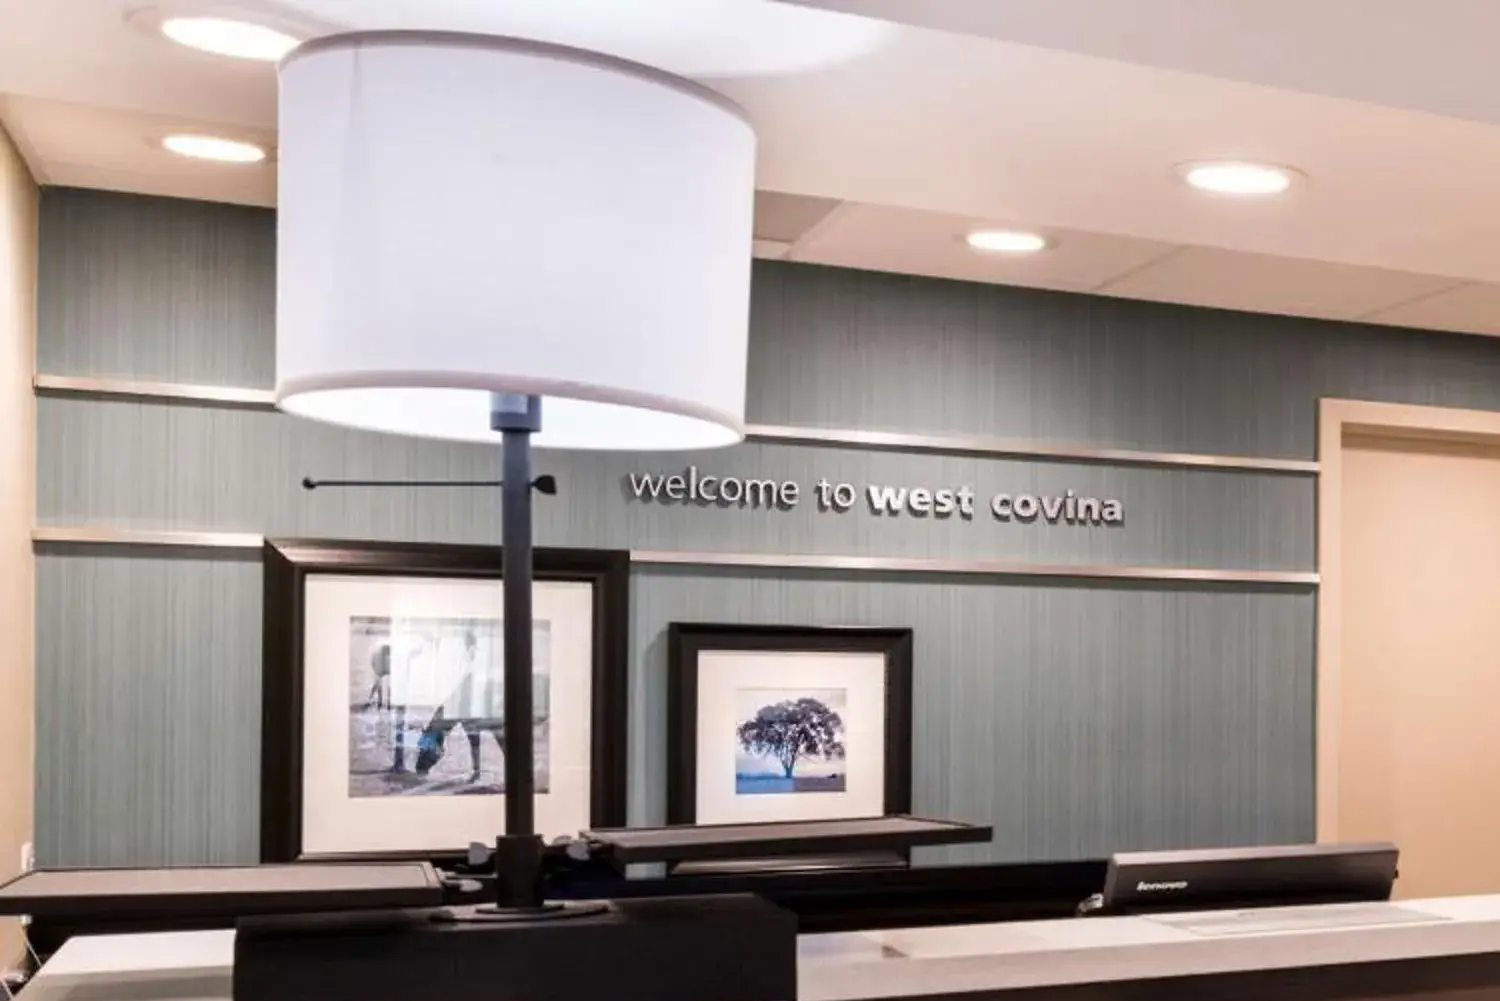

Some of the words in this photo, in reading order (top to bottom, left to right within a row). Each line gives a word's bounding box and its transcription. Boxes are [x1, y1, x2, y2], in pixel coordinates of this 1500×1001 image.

[628, 465, 800, 506] welcome
[817, 475, 858, 509] to
[868, 479, 974, 517] west
[991, 488, 1124, 524] covina
